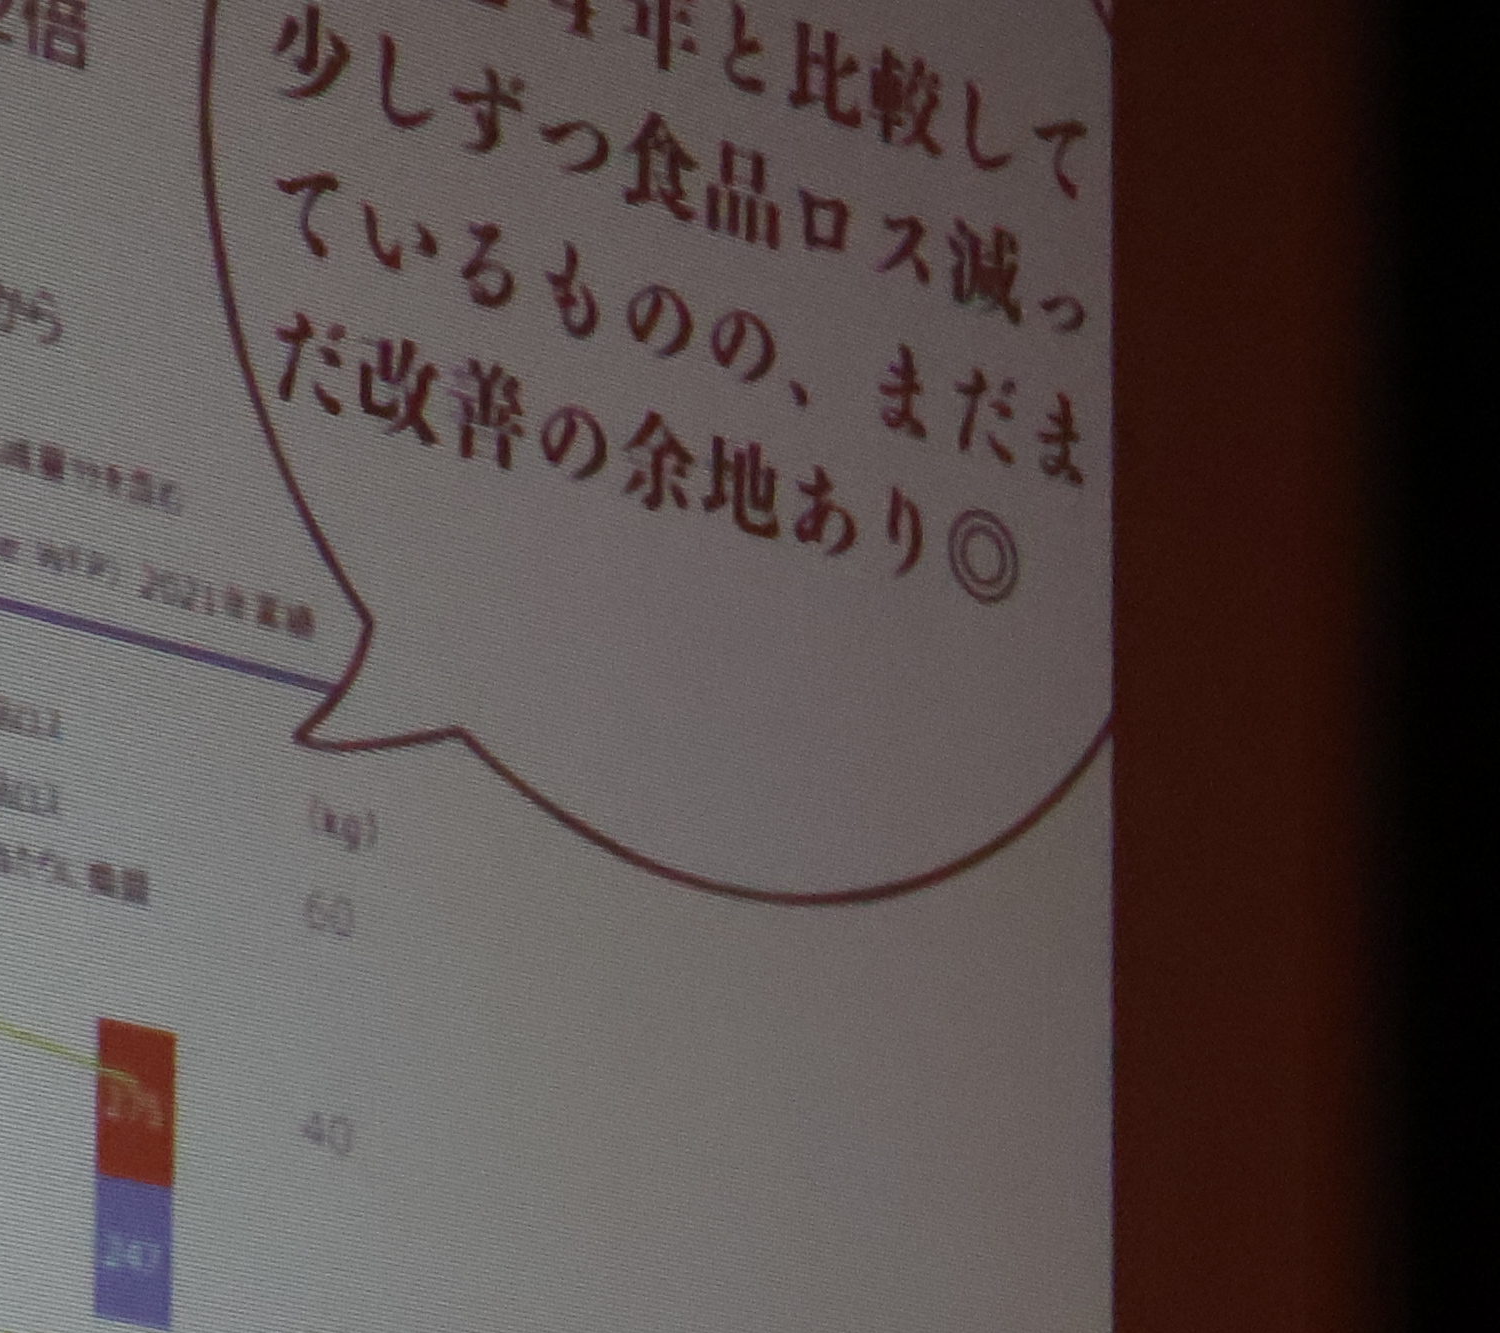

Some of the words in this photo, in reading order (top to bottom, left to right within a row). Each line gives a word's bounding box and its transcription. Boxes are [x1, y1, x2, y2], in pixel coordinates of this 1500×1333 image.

[274, 6, 1086, 332] 少しずつ食品ロス減っ
[275, 171, 1084, 485] ているものの、まだま
